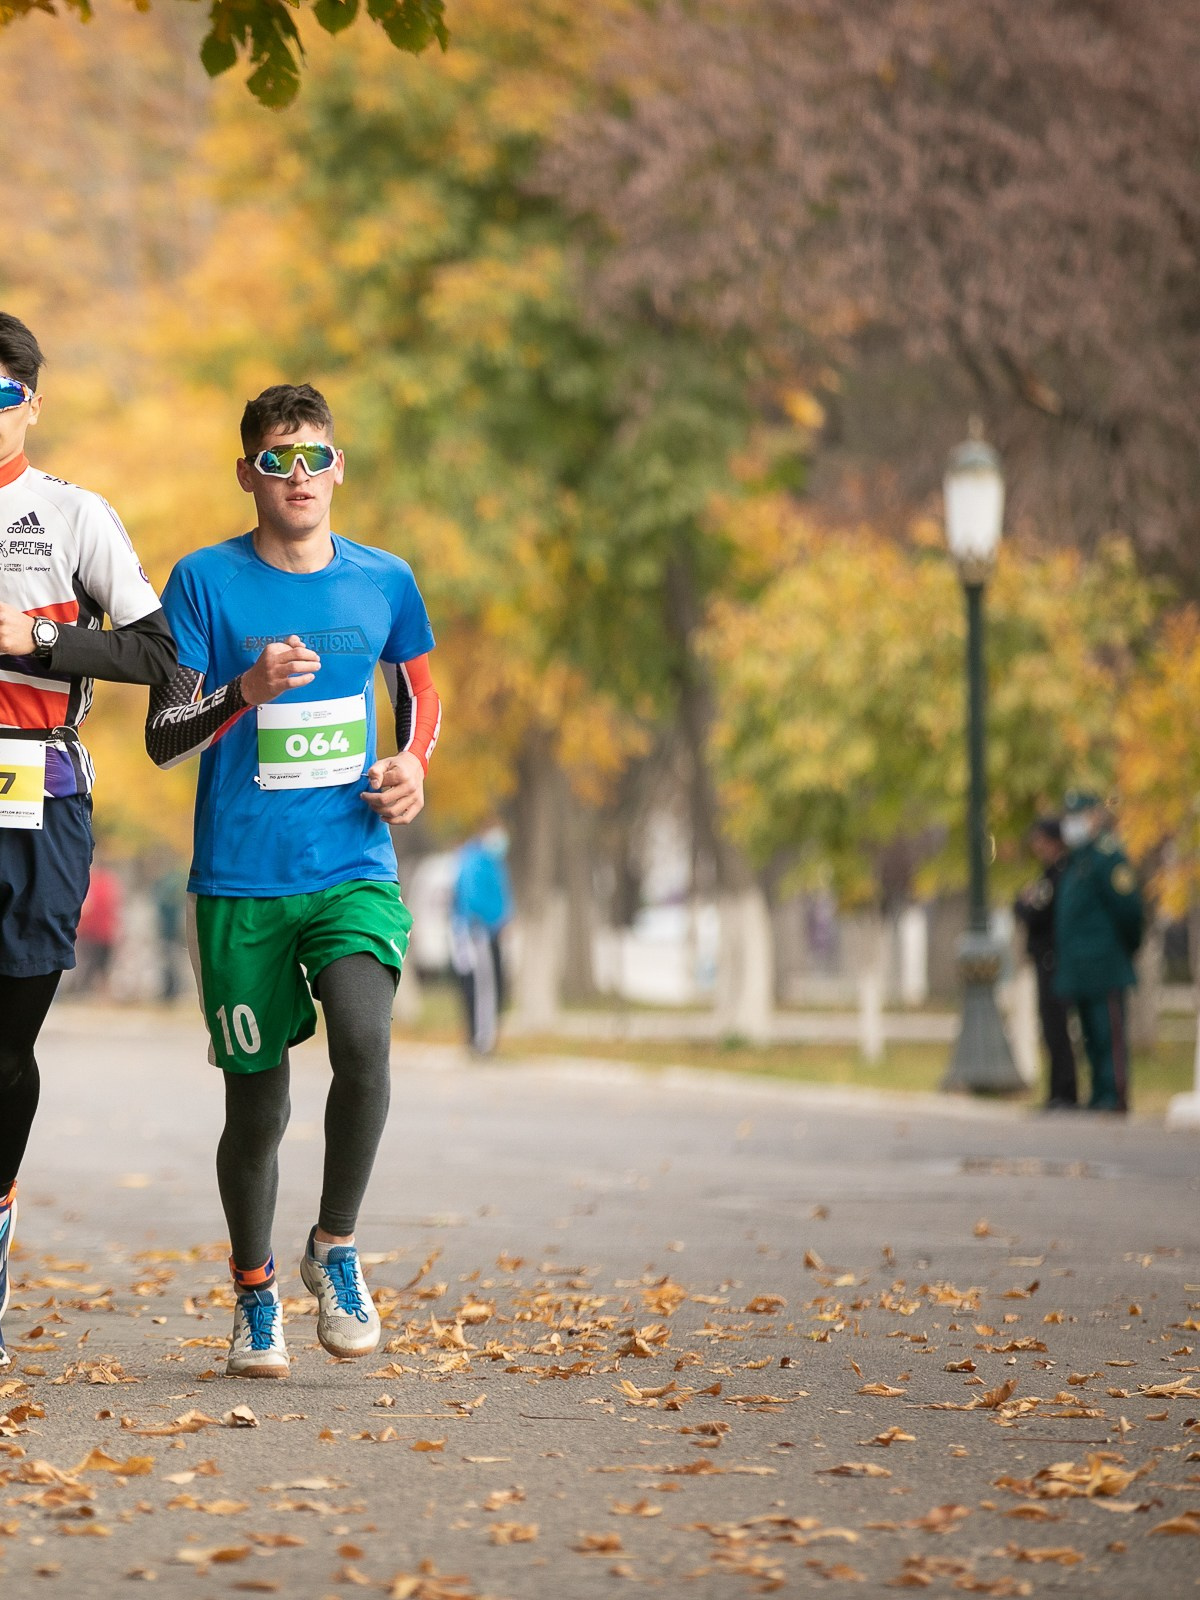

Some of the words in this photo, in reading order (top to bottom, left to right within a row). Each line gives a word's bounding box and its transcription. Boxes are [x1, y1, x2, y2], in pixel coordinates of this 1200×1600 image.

[6, 525, 45, 534] adidas
[9, 540, 53, 550] BRITISH
[9, 547, 52, 557] CYCLING
[285, 730, 350, 758] 064
[215, 1003, 262, 1056] 10
